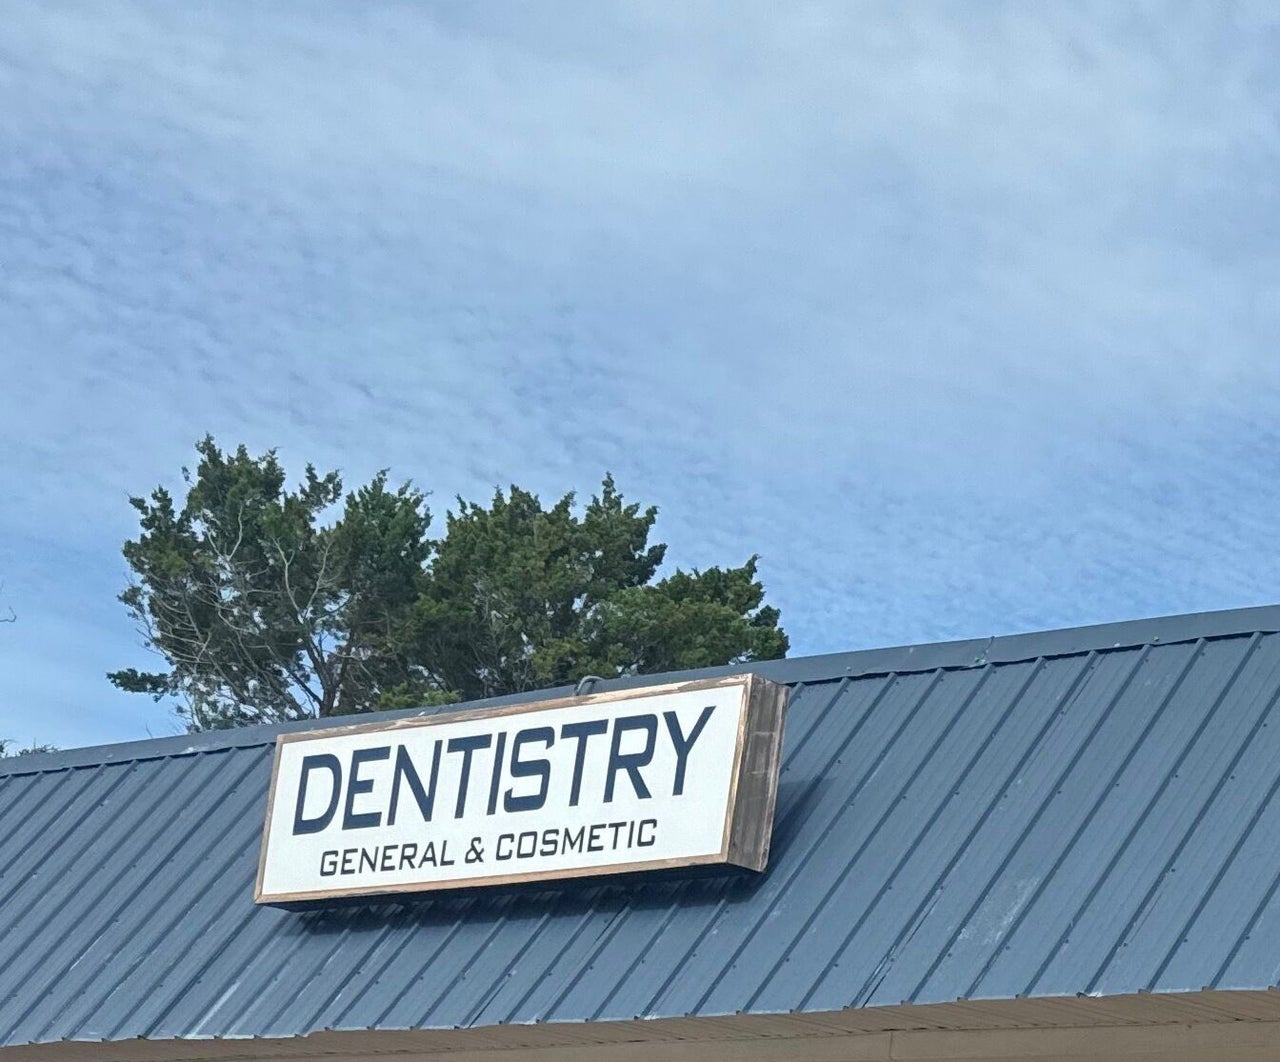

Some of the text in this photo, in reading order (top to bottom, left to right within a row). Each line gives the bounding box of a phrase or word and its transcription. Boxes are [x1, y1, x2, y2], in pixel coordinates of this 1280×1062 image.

[292, 706, 716, 836] DENTISTRY
[319, 818, 658, 877] GENERAL & COSMETIC
